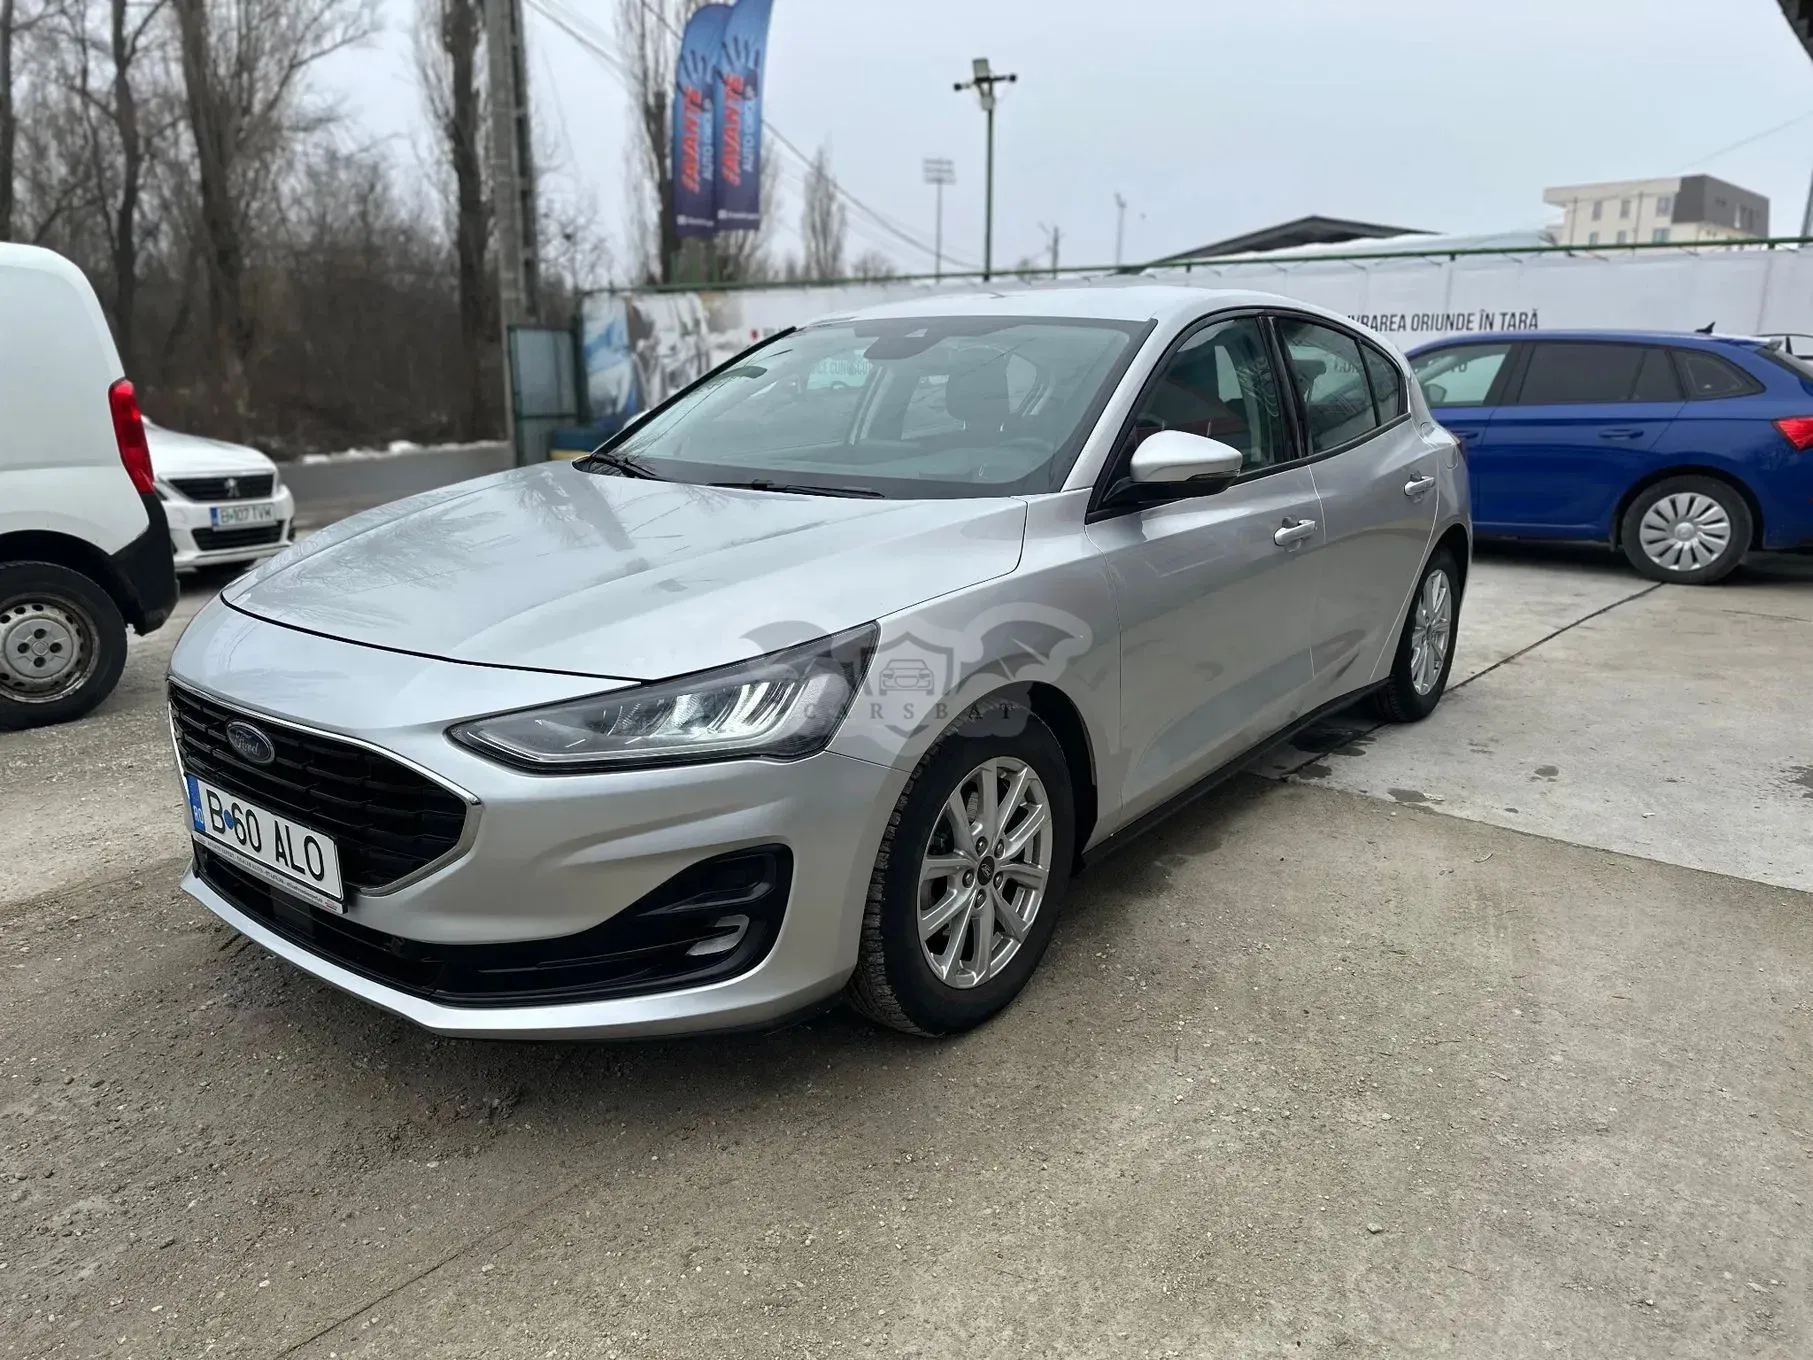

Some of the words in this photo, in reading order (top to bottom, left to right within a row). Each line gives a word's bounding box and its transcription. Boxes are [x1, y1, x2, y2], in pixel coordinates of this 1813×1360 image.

[1410, 312, 1475, 332] ORIUNDE
[1479, 308, 1495, 331] ÎN
[206, 789, 226, 834] B
[231, 802, 262, 853] 60
[274, 820, 325, 882] ALO
